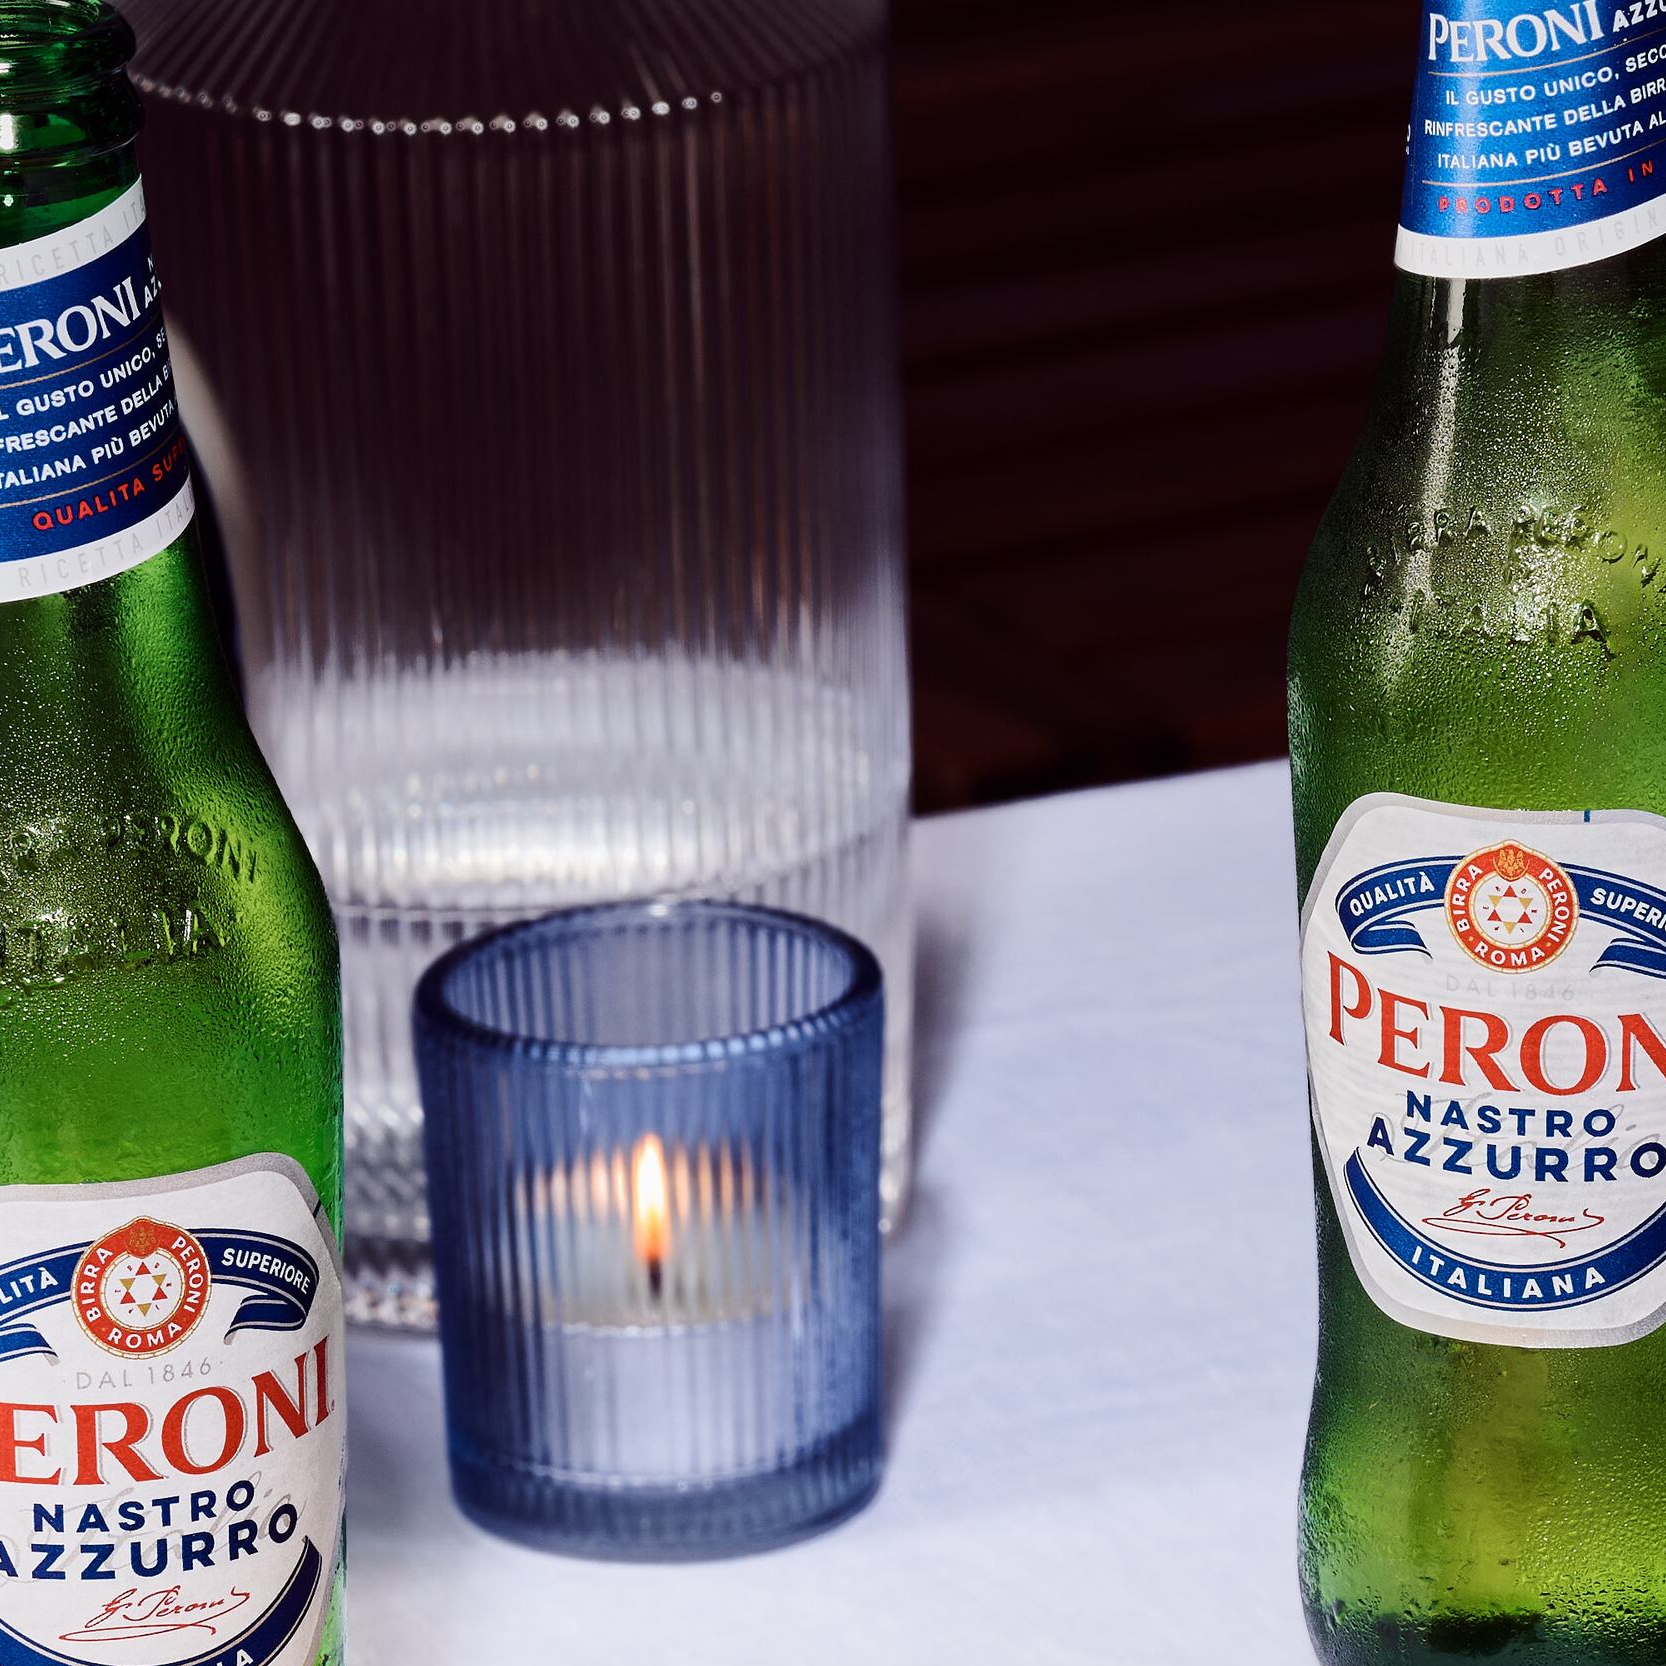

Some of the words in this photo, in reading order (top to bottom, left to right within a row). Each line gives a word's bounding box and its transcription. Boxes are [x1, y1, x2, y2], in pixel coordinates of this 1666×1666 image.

[1428, 0, 1605, 62] PERONI
[1445, 91, 1459, 106] IL
[1467, 85, 1535, 106] GUSTO
[1544, 67, 1619, 96] UNICO,
[1425, 113, 1557, 137] RINFRESCANTE
[1564, 94, 1626, 125] DELLA
[1438, 152, 1518, 169] ITALIANA
[1526, 143, 1561, 165] PIÙ
[1568, 120, 1644, 157] BEVUTA
[1649, 111, 1666, 130] AL
[1438, 178, 1607, 214] PRODOTTA
[1628, 160, 1653, 183] IN
[16, 380, 95, 415] GUSTO
[100, 347, 156, 388] UNICO,
[121, 375, 162, 415] DELLA
[91, 437, 124, 465] PIÙ
[129, 399, 174, 447] BEVUTA
[19, 532, 143, 588] RICETTA
[1350, 871, 1435, 917] QUALITÀ
[1453, 864, 1484, 933] BIRRA
[1538, 868, 1570, 943] PERONI
[1474, 942, 1546, 966] ROMA
[1406, 1090, 1616, 1138] NASTRO
[80, 1247, 113, 1323] BIRRA
[172, 1236, 204, 1313] PERONI
[221, 1247, 312, 1295] SUPERIORE
[1410, 1246, 1606, 1300] ITALIANA
[107, 1322, 182, 1348] ROMA
[77, 1369, 132, 1390] DAL
[148, 1357, 211, 1385] 1846
[33, 1480, 255, 1533] NASTRO
